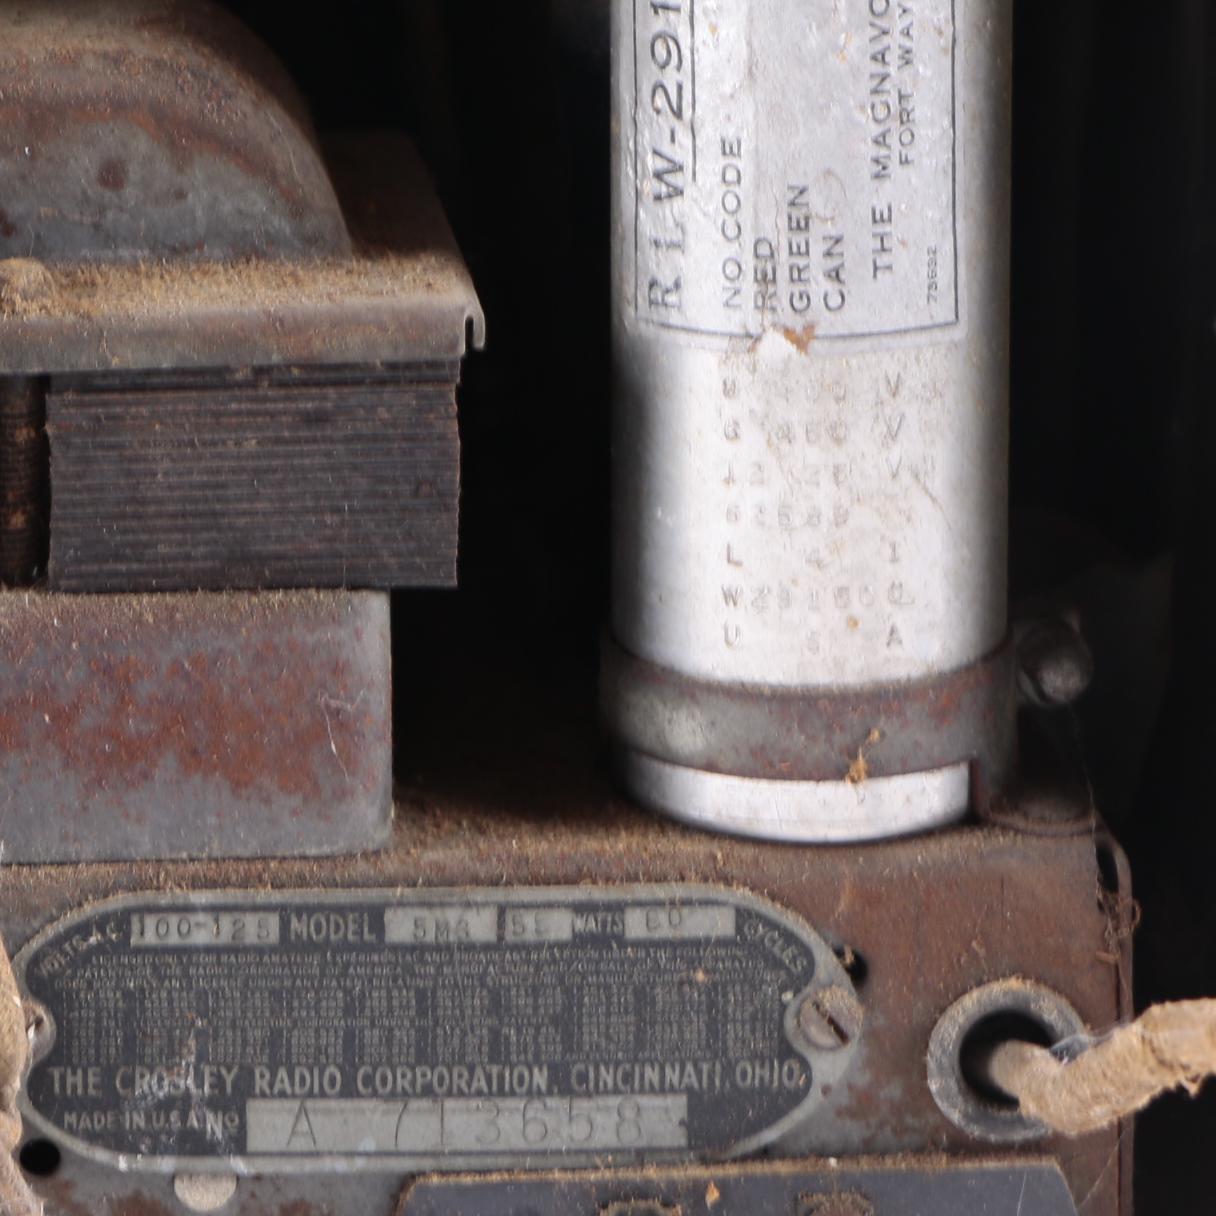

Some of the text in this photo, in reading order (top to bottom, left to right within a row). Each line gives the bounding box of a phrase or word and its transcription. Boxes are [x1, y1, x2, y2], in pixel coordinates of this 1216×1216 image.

[897, 87, 917, 167] FORT
[720, 136, 742, 243] CODE
[754, 236, 777, 313] RED
[788, 184, 812, 314] GREEN
[823, 234, 846, 313] CAN
[871, 202, 894, 280] THE
[135, 911, 272, 941] 100-125
[290, 910, 377, 945] MODEL
[571, 910, 625, 934] WATTS
[741, 920, 809, 974] CYCLES
[48, 1065, 103, 1096] THE
[114, 1064, 241, 1096] CROSLEY
[254, 1065, 343, 1095] RADIO
[63, 1109, 114, 1130] MADE
[124, 1108, 146, 1130] IN
[396, 1094, 642, 1148] 713658
